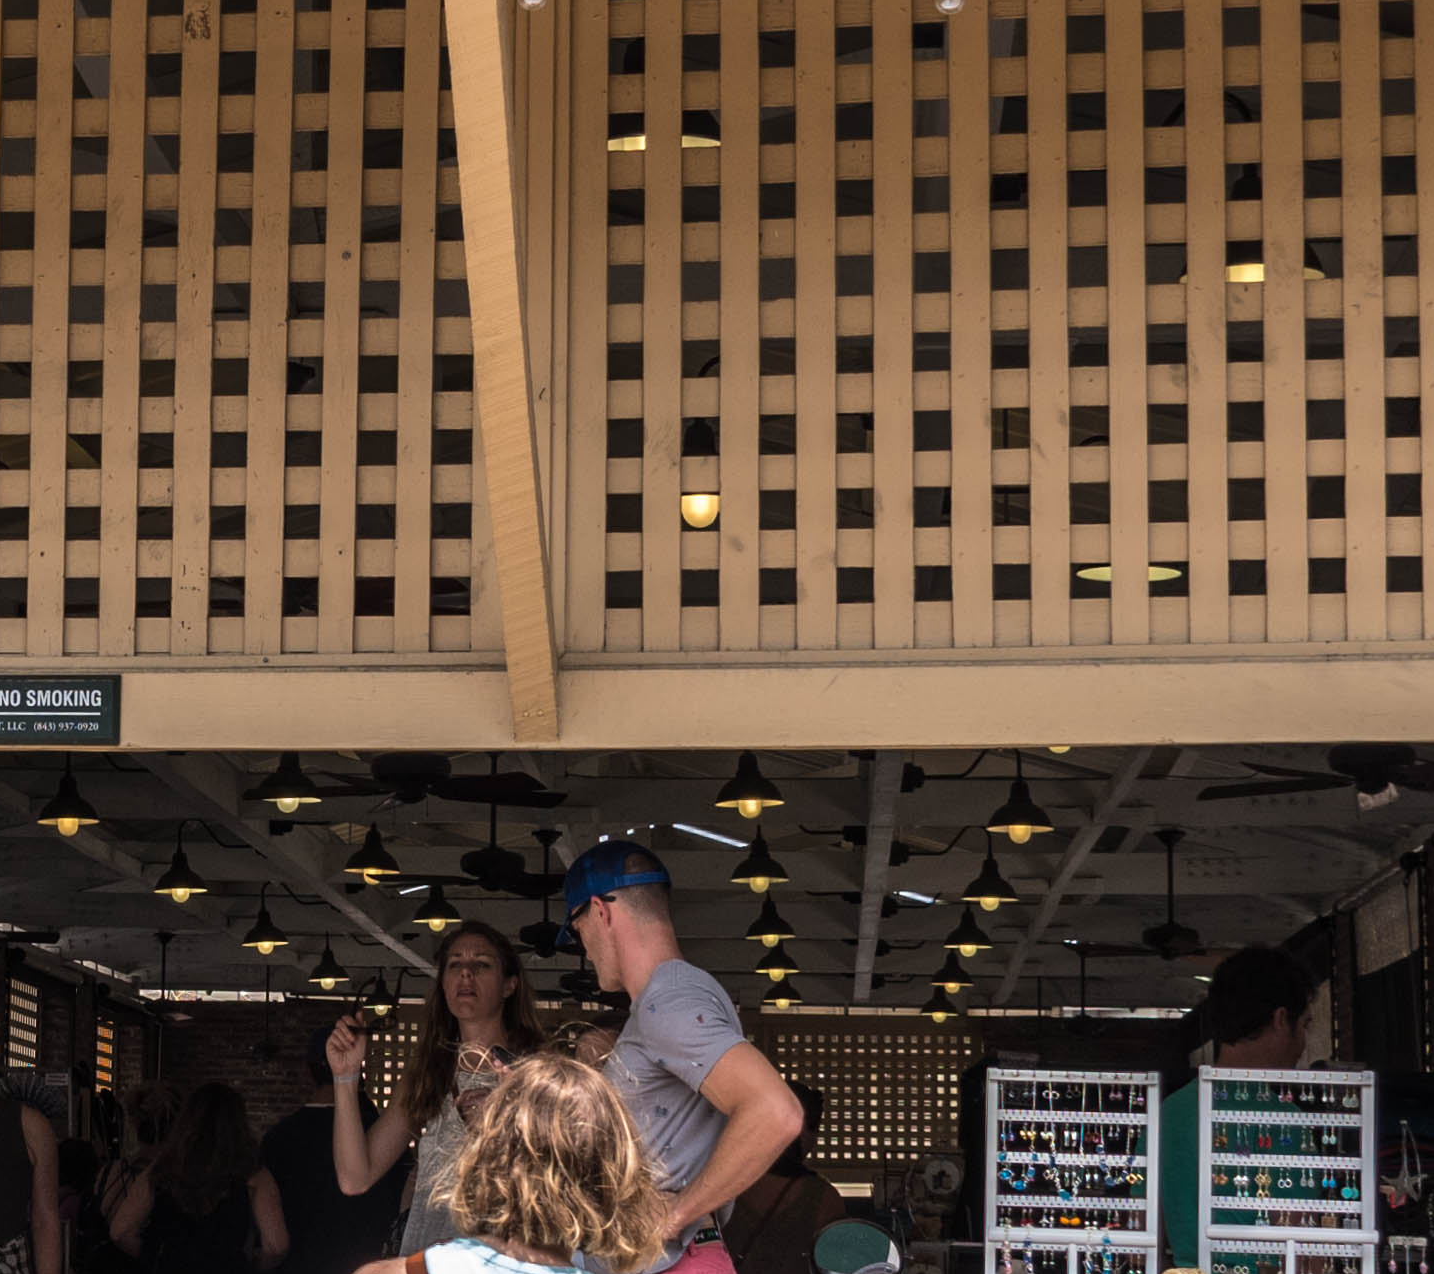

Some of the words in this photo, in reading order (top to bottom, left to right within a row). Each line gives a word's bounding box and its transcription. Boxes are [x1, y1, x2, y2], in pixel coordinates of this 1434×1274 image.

[26, 690, 102, 707] SMOKING
[7, 721, 26, 731] LLC
[33, 722, 56, 732] (843)
[58, 722, 99, 731] 937-0920
